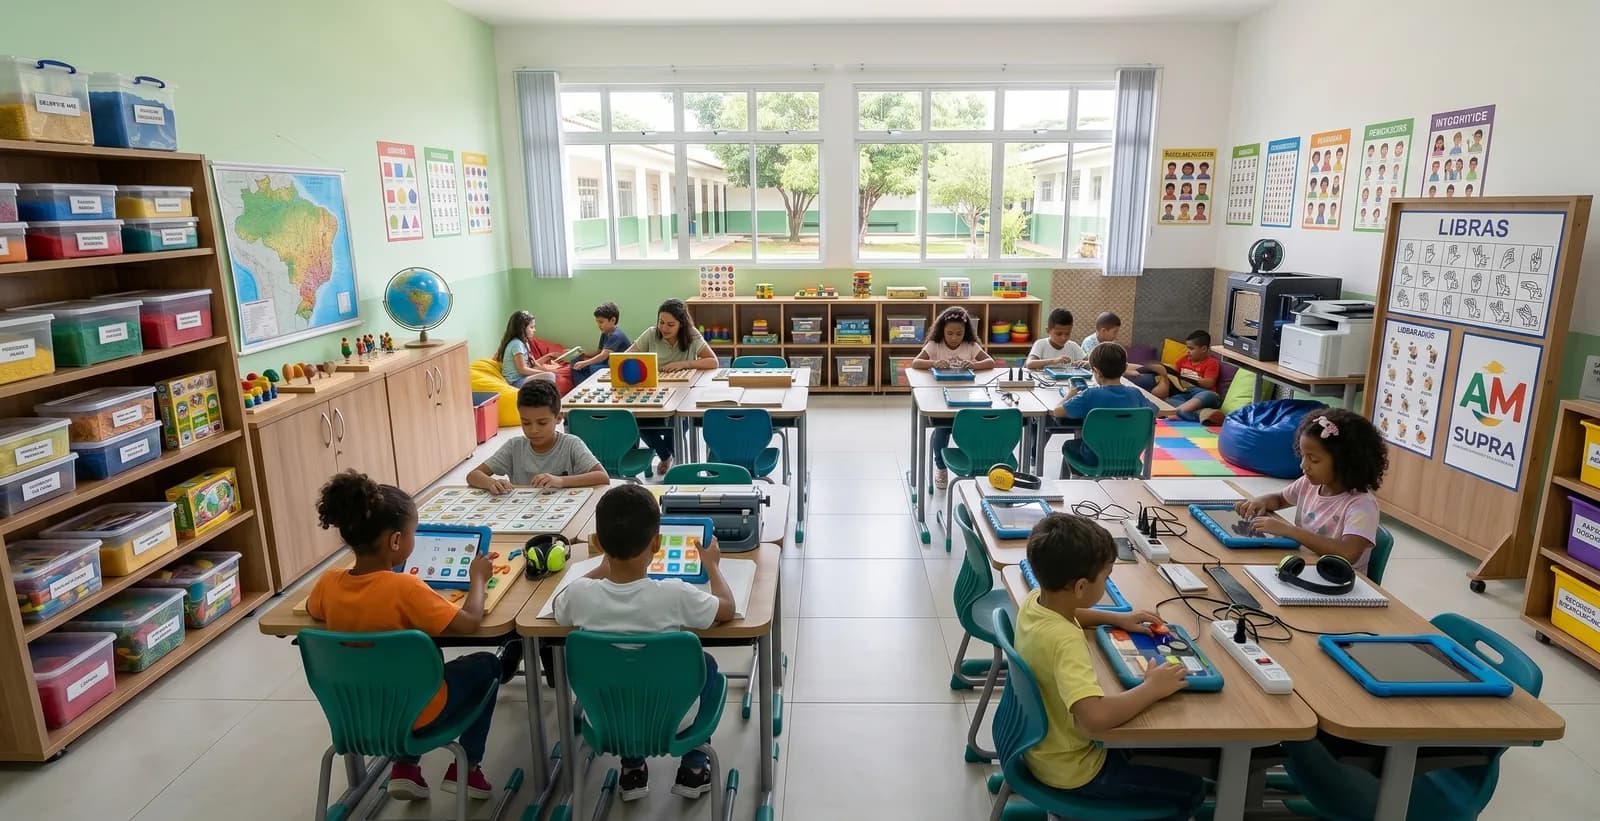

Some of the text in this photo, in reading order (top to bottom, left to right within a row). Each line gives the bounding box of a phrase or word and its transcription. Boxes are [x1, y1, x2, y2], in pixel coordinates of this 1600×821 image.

[1438, 218, 1510, 238] LIBRAS
[1459, 371, 1527, 424] AM
[1453, 426, 1515, 461] SUPRA
